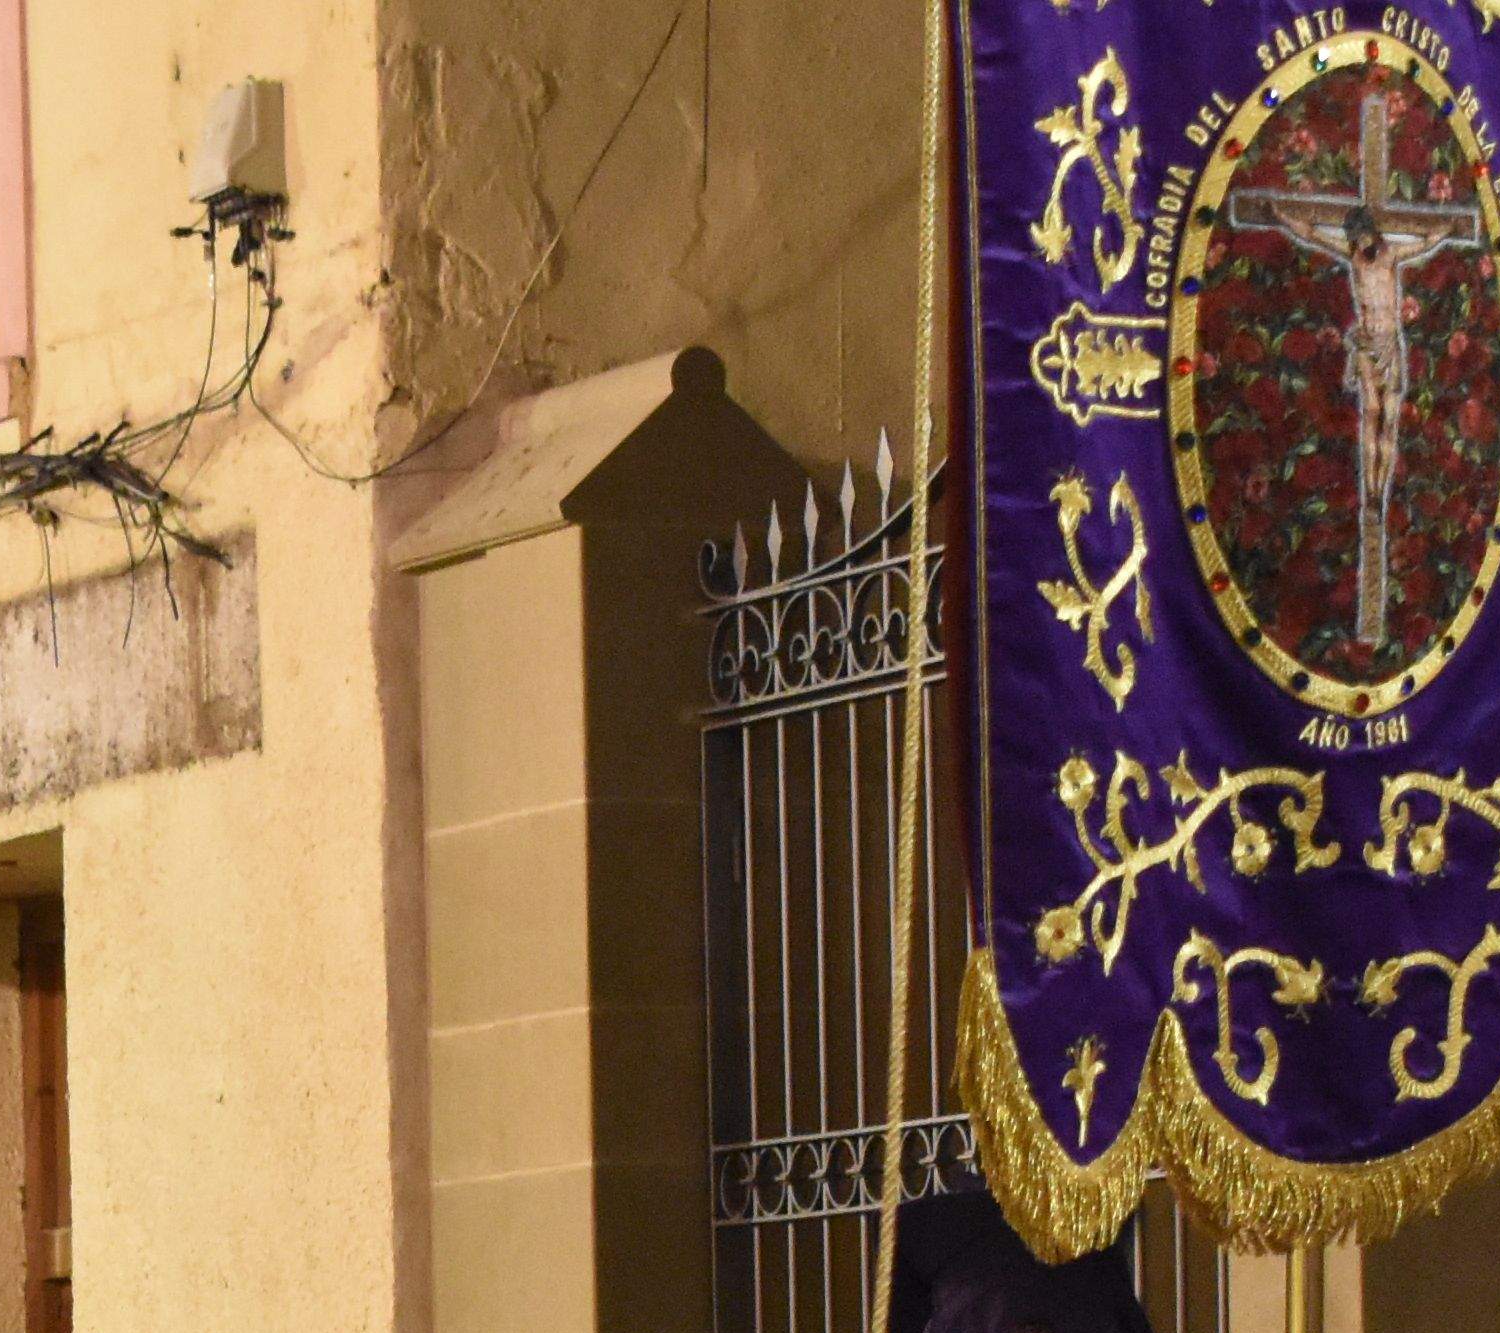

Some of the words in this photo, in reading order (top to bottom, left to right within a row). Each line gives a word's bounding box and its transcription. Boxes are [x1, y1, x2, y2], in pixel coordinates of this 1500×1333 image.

[1145, 165, 1195, 308] COFRADIA
[1184, 91, 1237, 147] DEL
[1256, 6, 1345, 71] SANTO
[1381, 5, 1450, 71] CRISTO
[1457, 84, 1481, 121] DE
[1476, 121, 1497, 161] LA
[1298, 713, 1349, 751] AÑO
